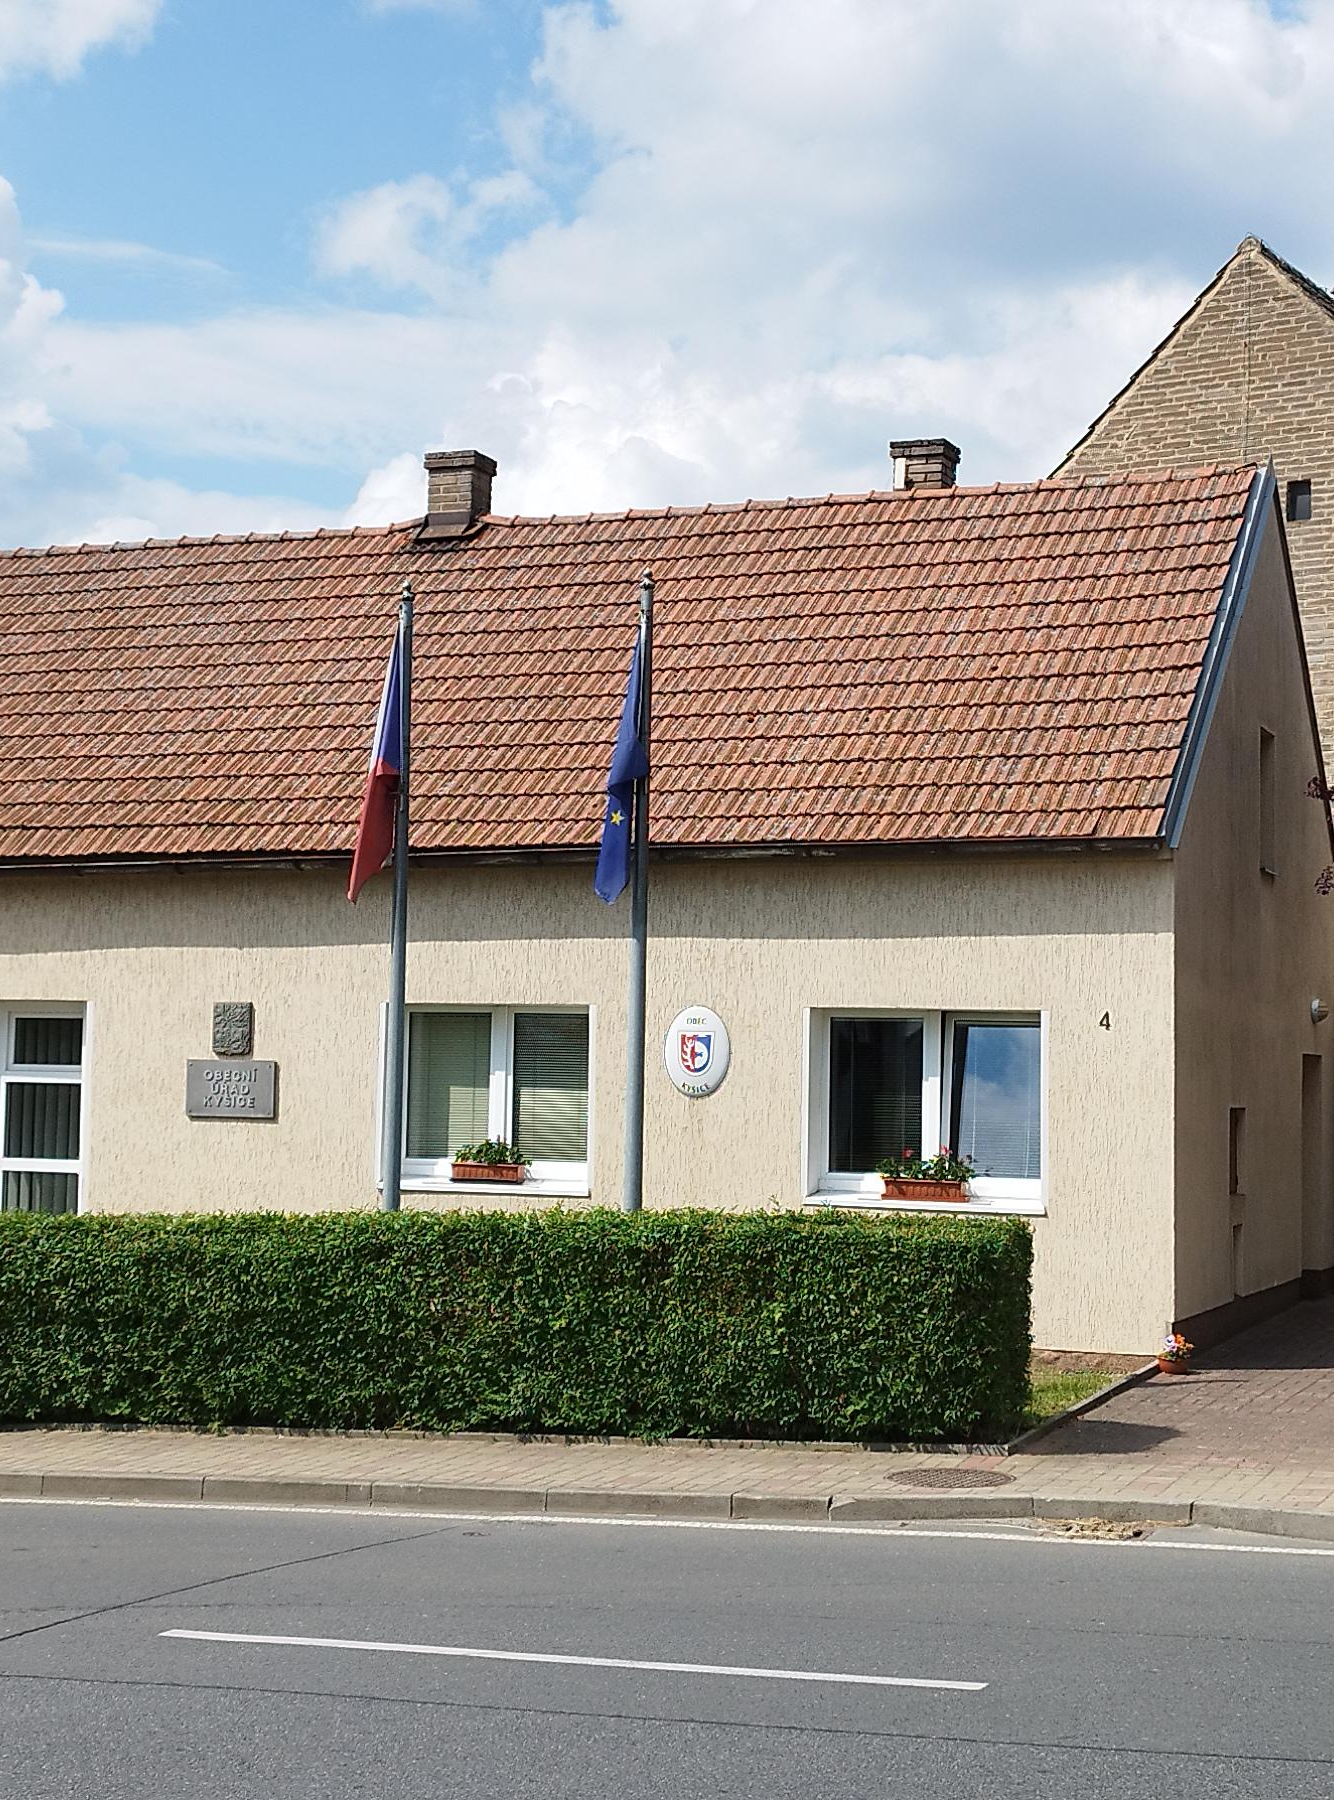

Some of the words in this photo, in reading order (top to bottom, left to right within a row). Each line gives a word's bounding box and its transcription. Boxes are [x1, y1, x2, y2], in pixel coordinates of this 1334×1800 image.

[1099, 1011, 1111, 1031] 4
[204, 1068, 258, 1083] OBECNÍ
[211, 1081, 250, 1096] ÚŘAD
